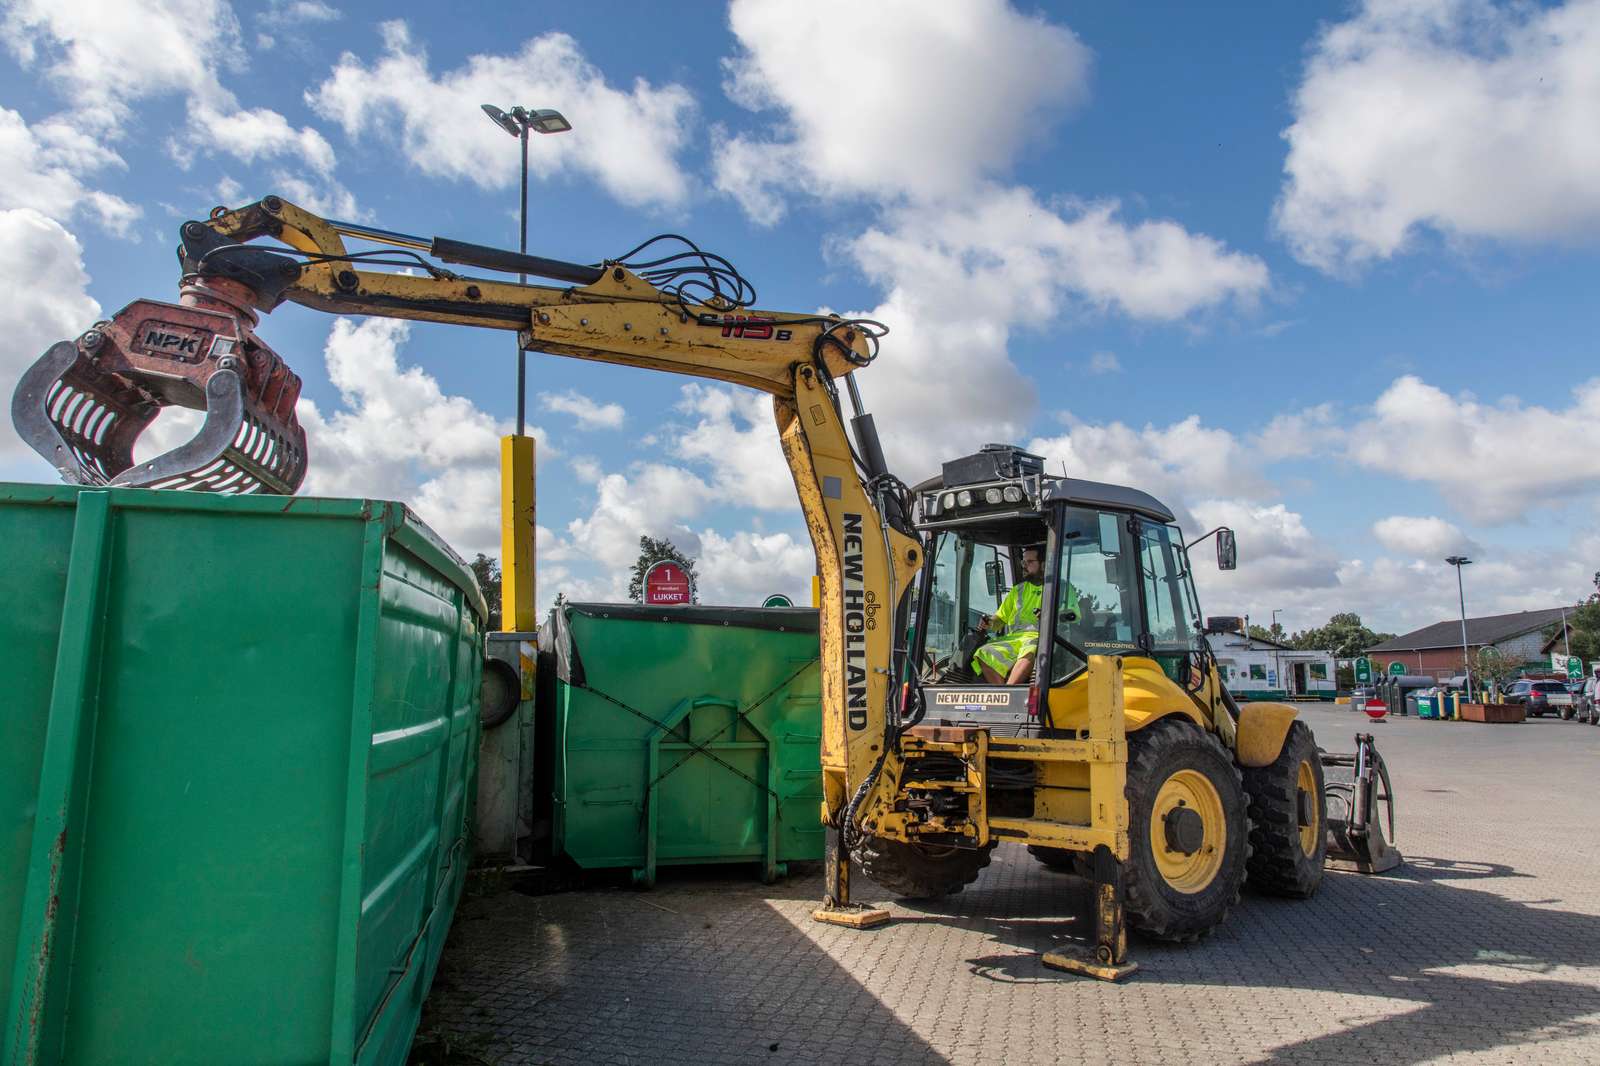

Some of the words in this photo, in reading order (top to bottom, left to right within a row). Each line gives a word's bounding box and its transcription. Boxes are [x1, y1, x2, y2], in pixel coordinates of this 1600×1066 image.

[145, 331, 199, 353] NPK
[844, 513, 864, 582] NEW
[665, 569, 671, 582] 1
[653, 593, 684, 601] LUKKET
[865, 590, 882, 631] cbc
[845, 589, 868, 731] HOLLAND
[937, 693, 960, 704] NEW
[961, 694, 1009, 705] HOLLAND
